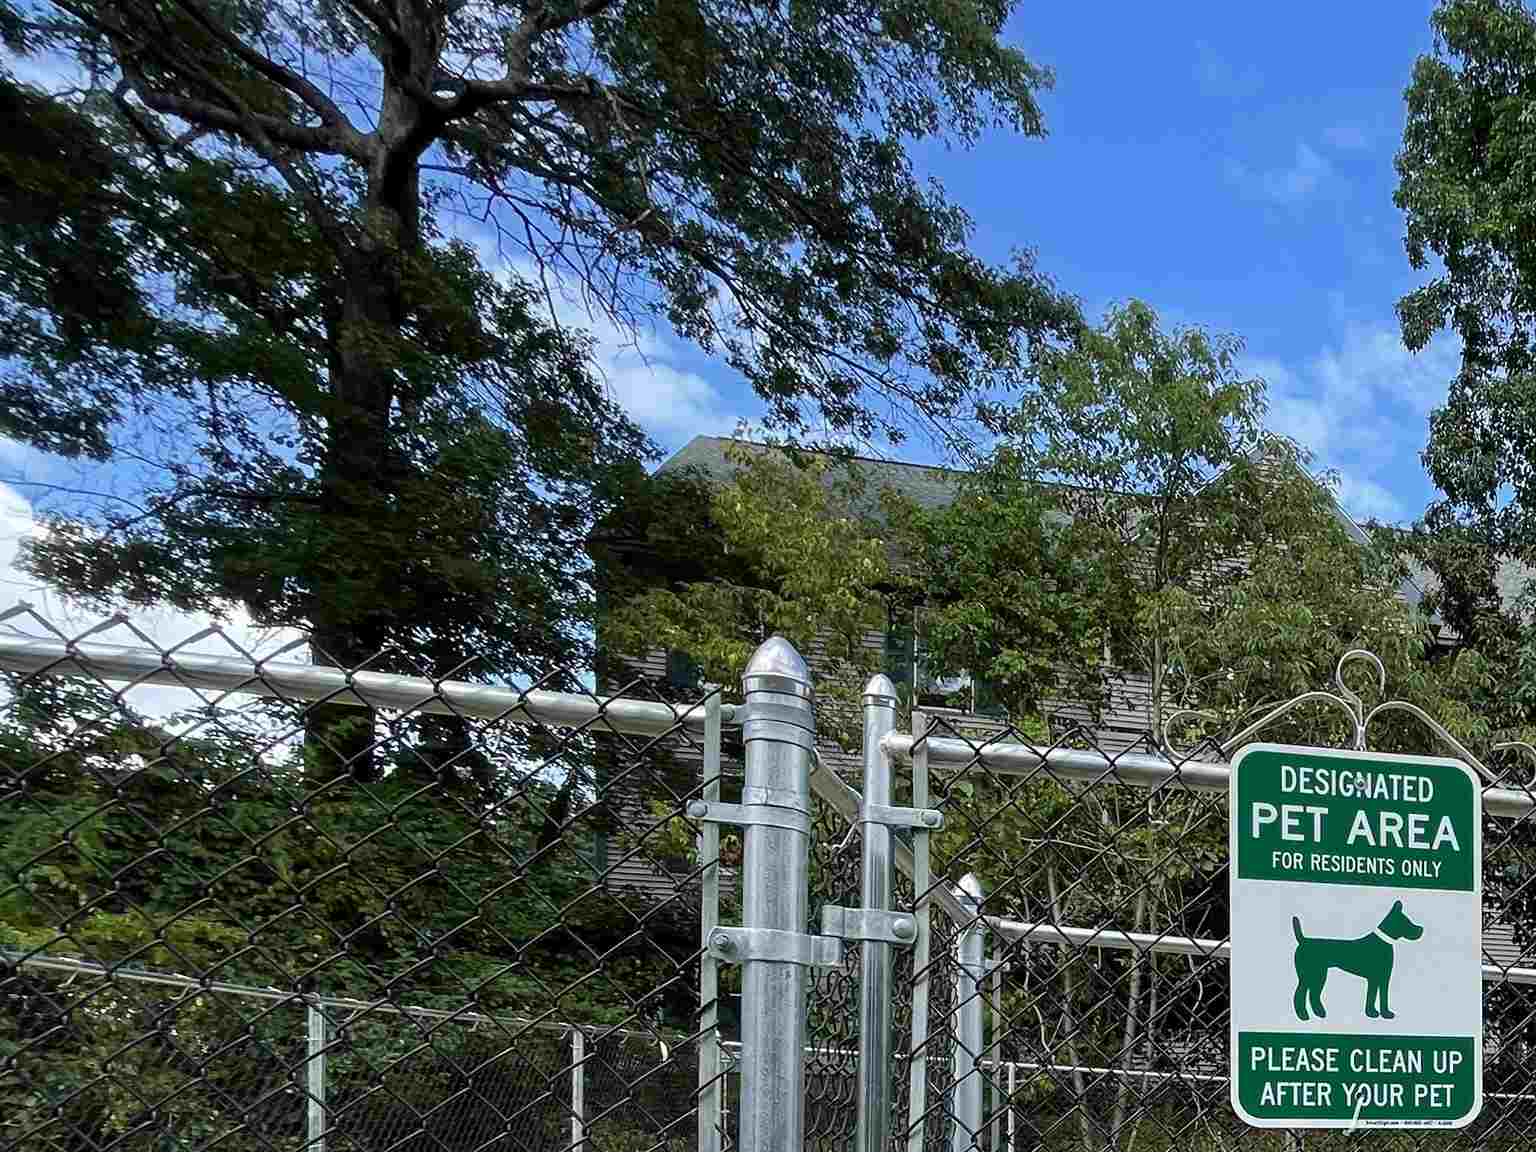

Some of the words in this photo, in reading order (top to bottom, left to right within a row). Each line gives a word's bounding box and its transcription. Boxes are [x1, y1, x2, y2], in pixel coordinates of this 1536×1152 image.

[1280, 764, 1434, 803] DESIGNATED
[1251, 801, 1329, 843] PET
[1346, 809, 1461, 852] AREA
[1271, 850, 1304, 871] FOR
[1310, 853, 1396, 876] RESIDENTS
[1401, 858, 1442, 879] ONLY
[1250, 1046, 1339, 1073] PLEASE
[1350, 1049, 1422, 1074] CLEAN
[1432, 1050, 1463, 1075] UP
[1260, 1081, 1332, 1107] AFTER
[1342, 1083, 1404, 1108] YOUR
[1414, 1084, 1455, 1108] PET
